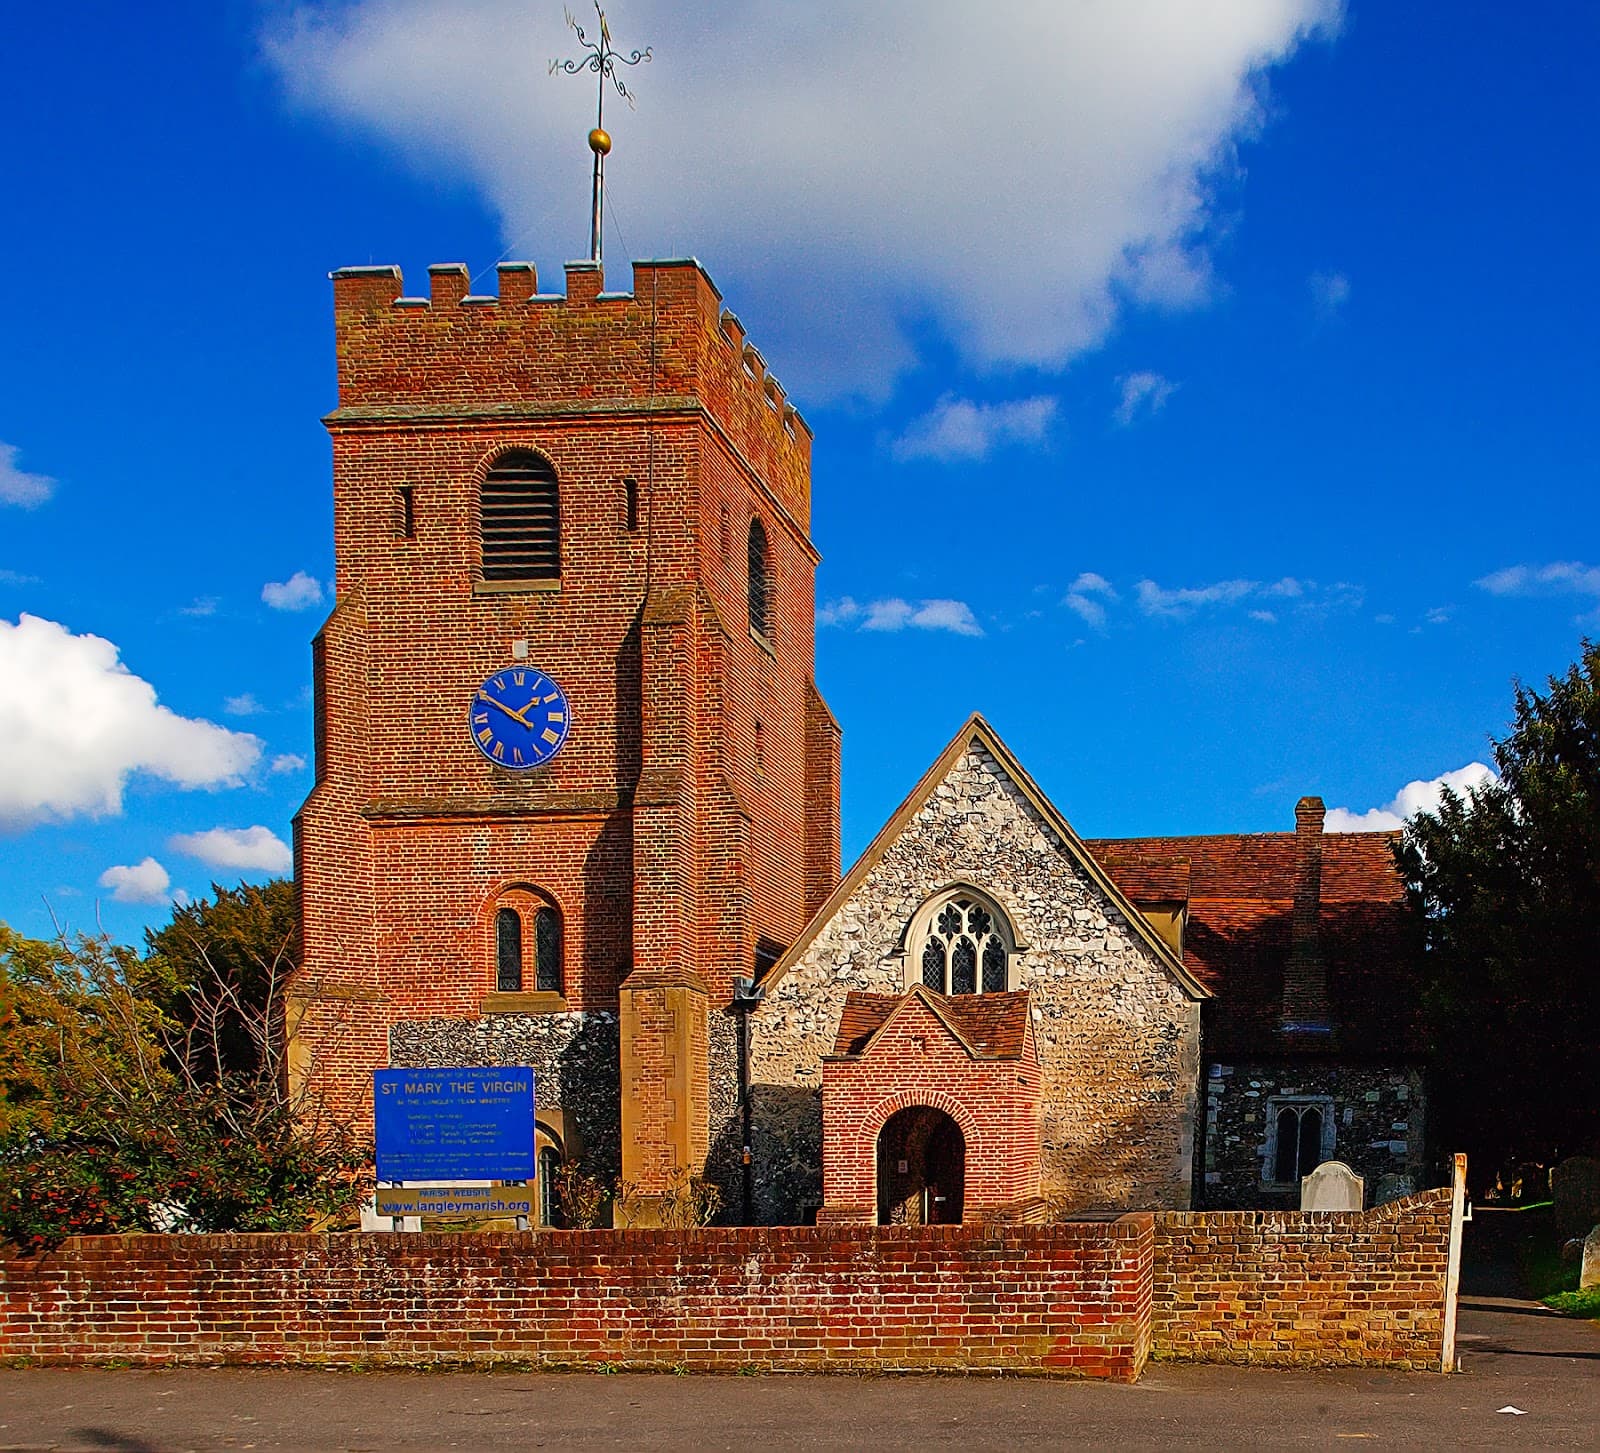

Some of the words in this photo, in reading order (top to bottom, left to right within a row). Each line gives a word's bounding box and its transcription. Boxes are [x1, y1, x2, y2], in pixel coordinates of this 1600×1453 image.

[467, 1070, 501, 1078] ENGLAND
[381, 1083, 399, 1095] ST
[404, 1082, 443, 1094] MARY
[449, 1081, 476, 1094] THE
[482, 1080, 527, 1093] VIRGIN
[454, 1189, 491, 1197] WEBSITE
[381, 1199, 530, 1214] www.langleymarish.org
